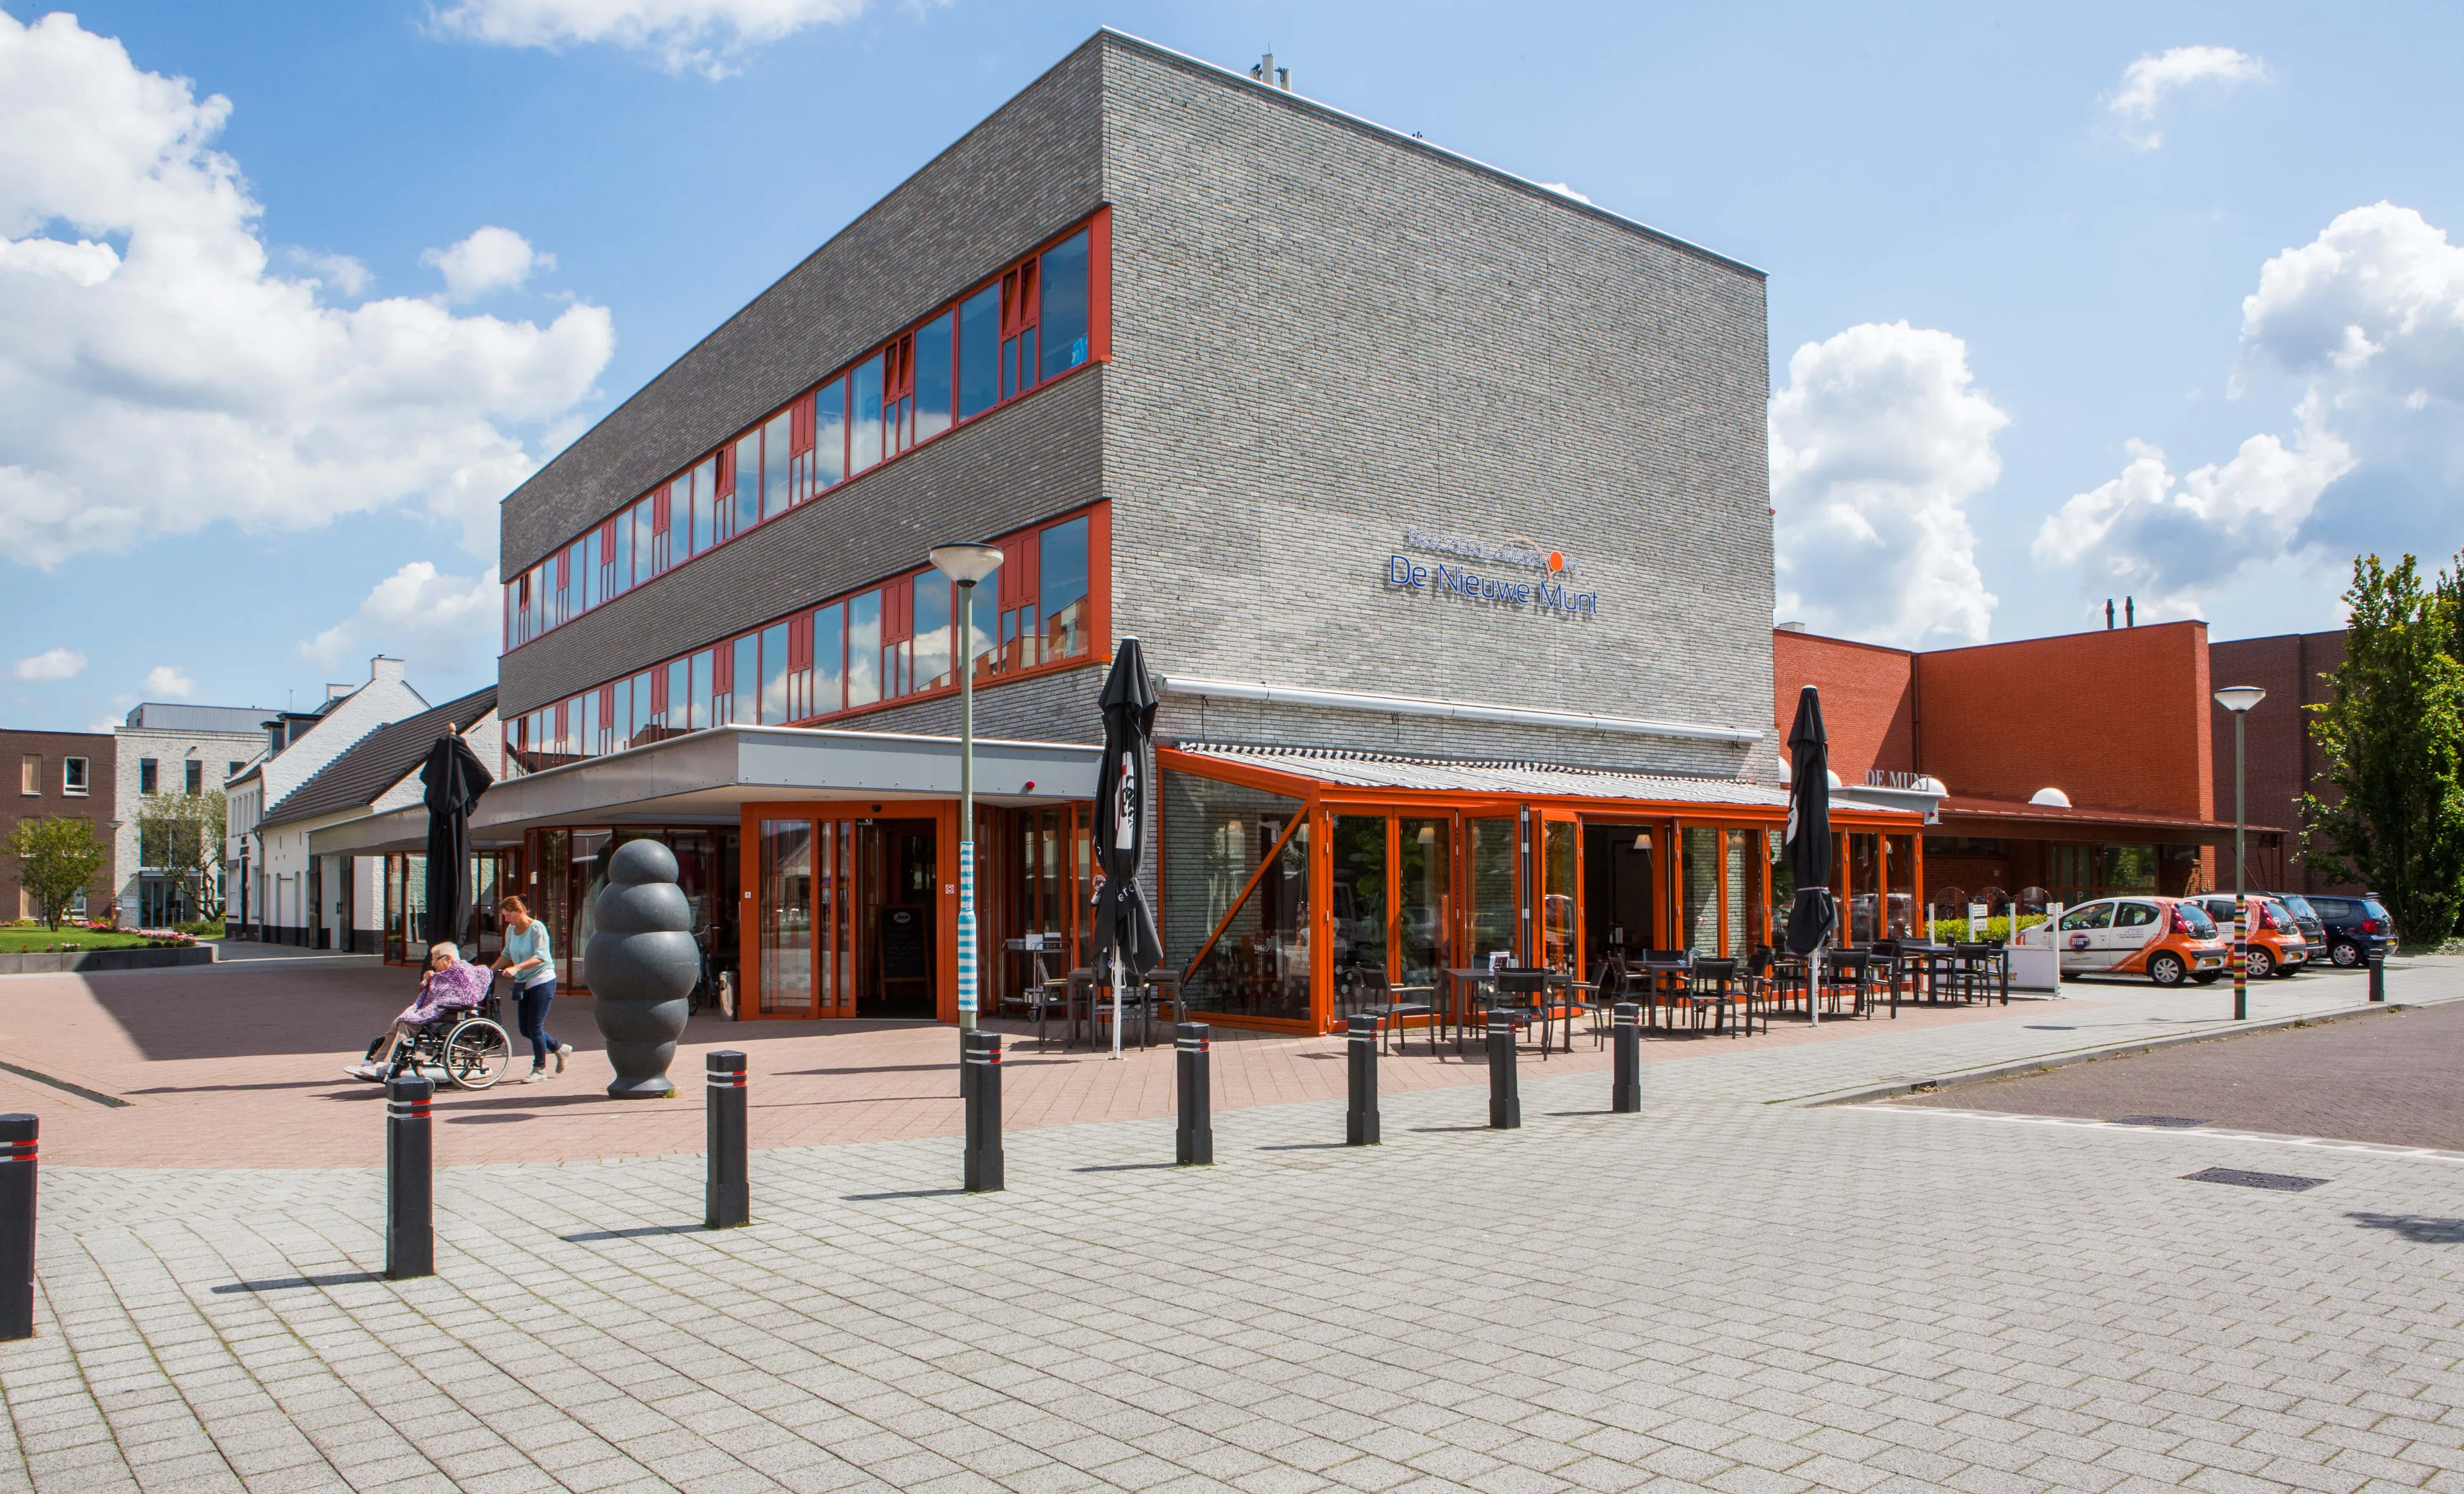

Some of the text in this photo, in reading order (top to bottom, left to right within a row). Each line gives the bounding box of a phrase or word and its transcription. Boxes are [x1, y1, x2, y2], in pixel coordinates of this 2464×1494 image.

[1408, 528, 1493, 558] BRASSERIE
[1390, 554, 1598, 614] De Nieuwe Munt
[1865, 769, 1932, 792] DE MUNT
